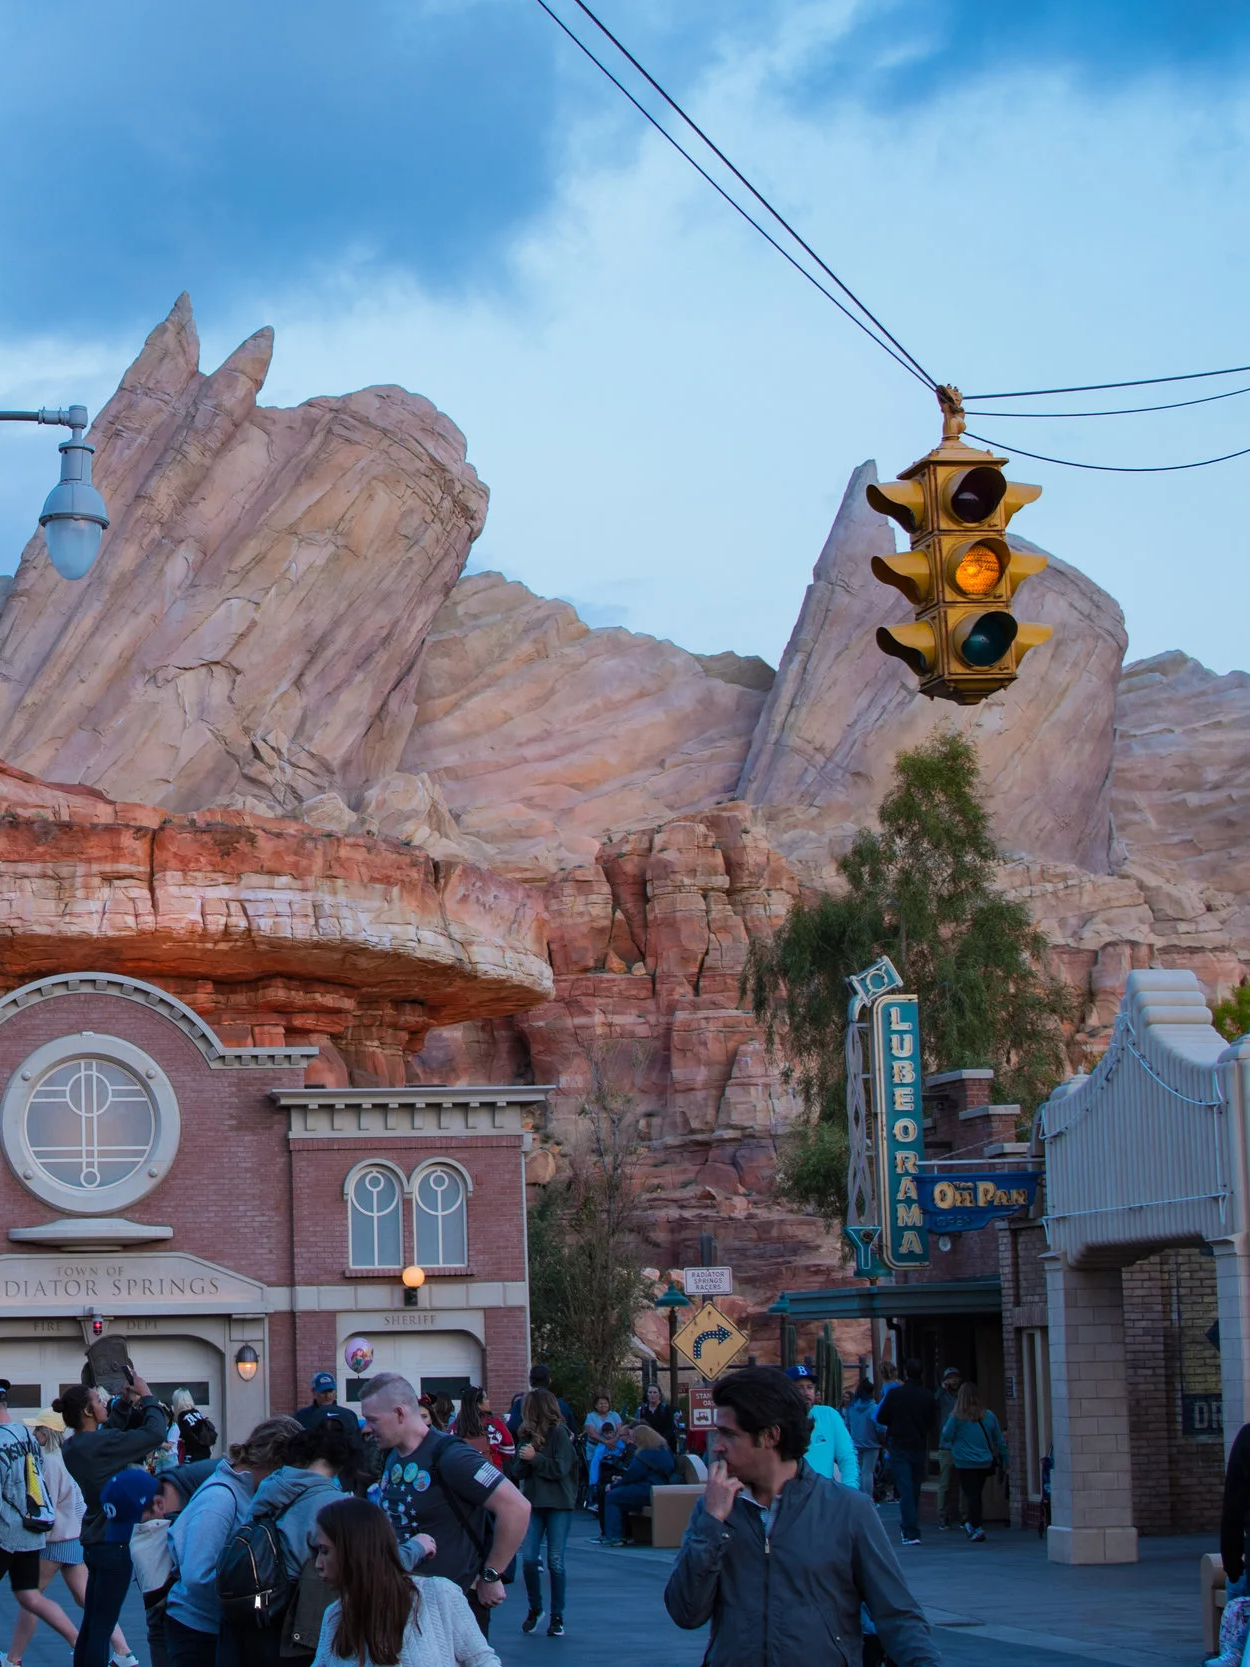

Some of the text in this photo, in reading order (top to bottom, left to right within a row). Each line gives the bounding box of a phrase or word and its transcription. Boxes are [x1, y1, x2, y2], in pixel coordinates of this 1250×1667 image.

[56, 1266, 125, 1276] TOWN OF
[112, 1277, 219, 1296] SPRINGS
[33, 1319, 159, 1331] FIRE DEPT
[383, 1314, 437, 1326] SHERIFF
